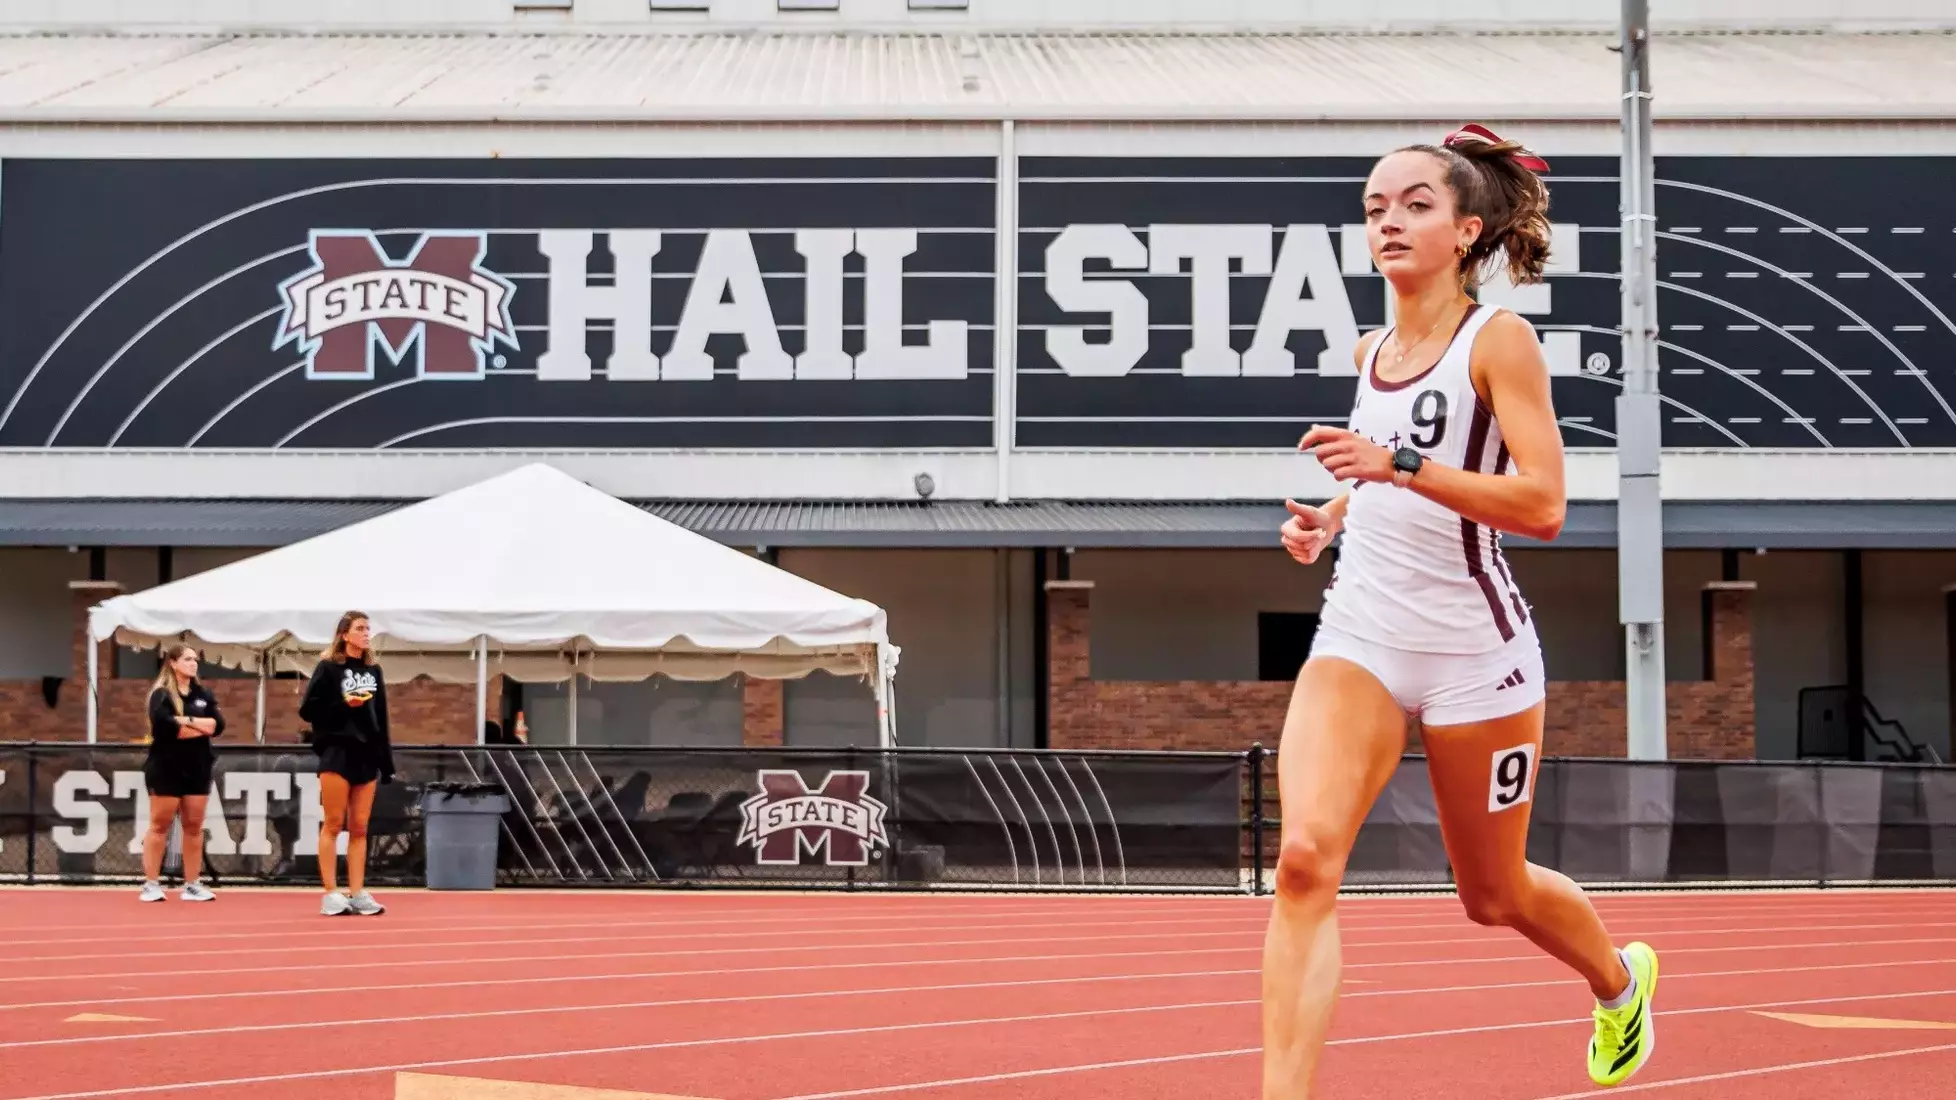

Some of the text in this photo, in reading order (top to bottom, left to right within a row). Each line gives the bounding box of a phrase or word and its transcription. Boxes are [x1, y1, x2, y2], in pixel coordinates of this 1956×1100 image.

[325, 278, 468, 321] STATE
[537, 223, 1580, 381] HAIL STAE
[1410, 389, 1448, 449] 9
[341, 668, 378, 691] State
[1496, 750, 1528, 805] 9
[768, 801, 858, 829] STATE
